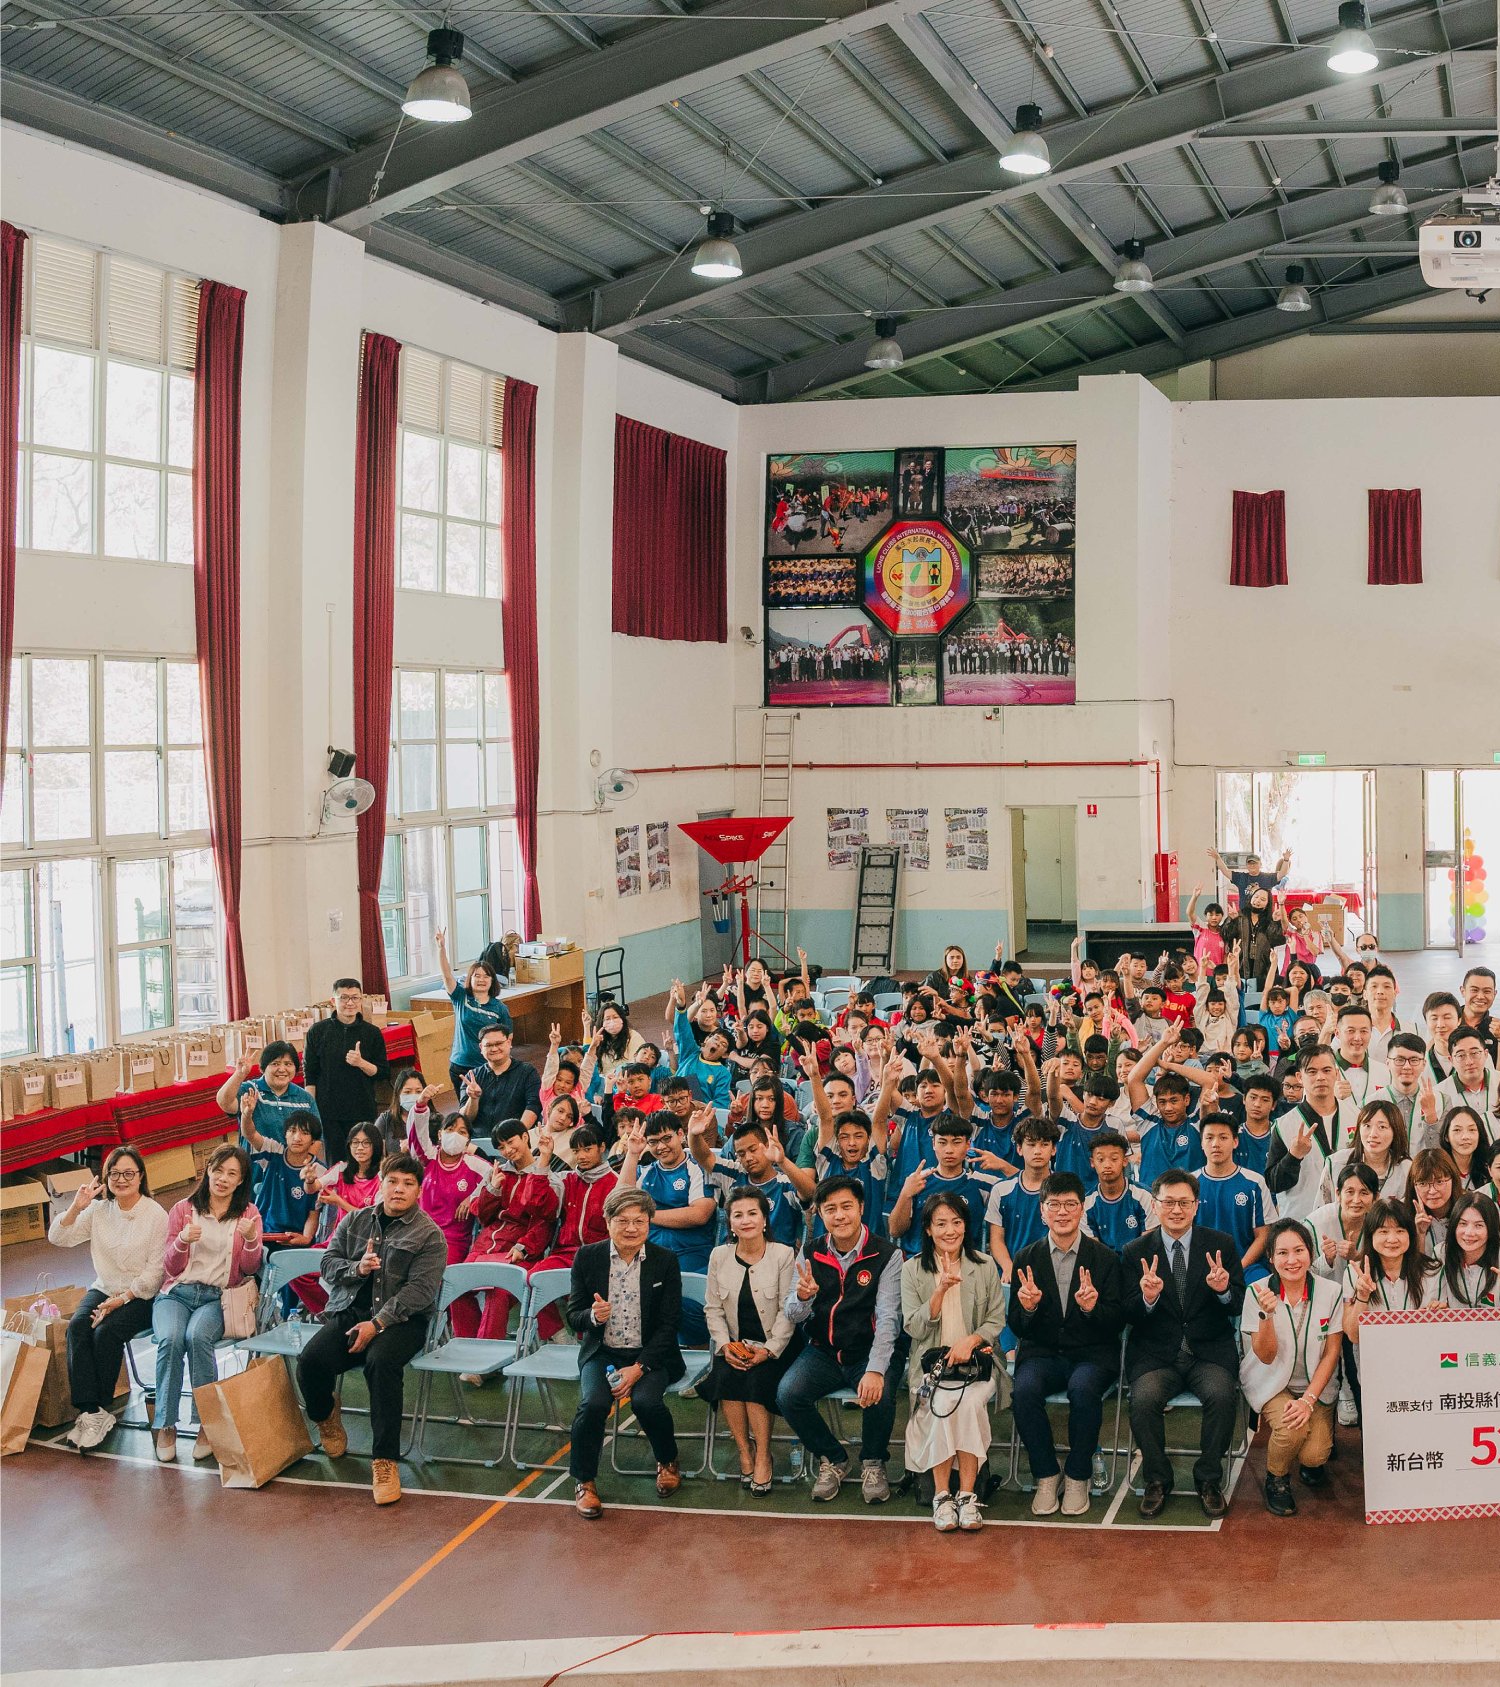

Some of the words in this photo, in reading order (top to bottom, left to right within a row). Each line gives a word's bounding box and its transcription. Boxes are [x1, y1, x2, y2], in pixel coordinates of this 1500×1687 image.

[876, 554, 885, 573] LIONS
[882, 537, 897, 555] CLUBS
[896, 527, 937, 541] INTERNATIONAL
[949, 548, 961, 570] TAIWAN
[1386, 1399, 1434, 1413] 憑票支付
[1386, 1450, 1444, 1472] 新台幣
